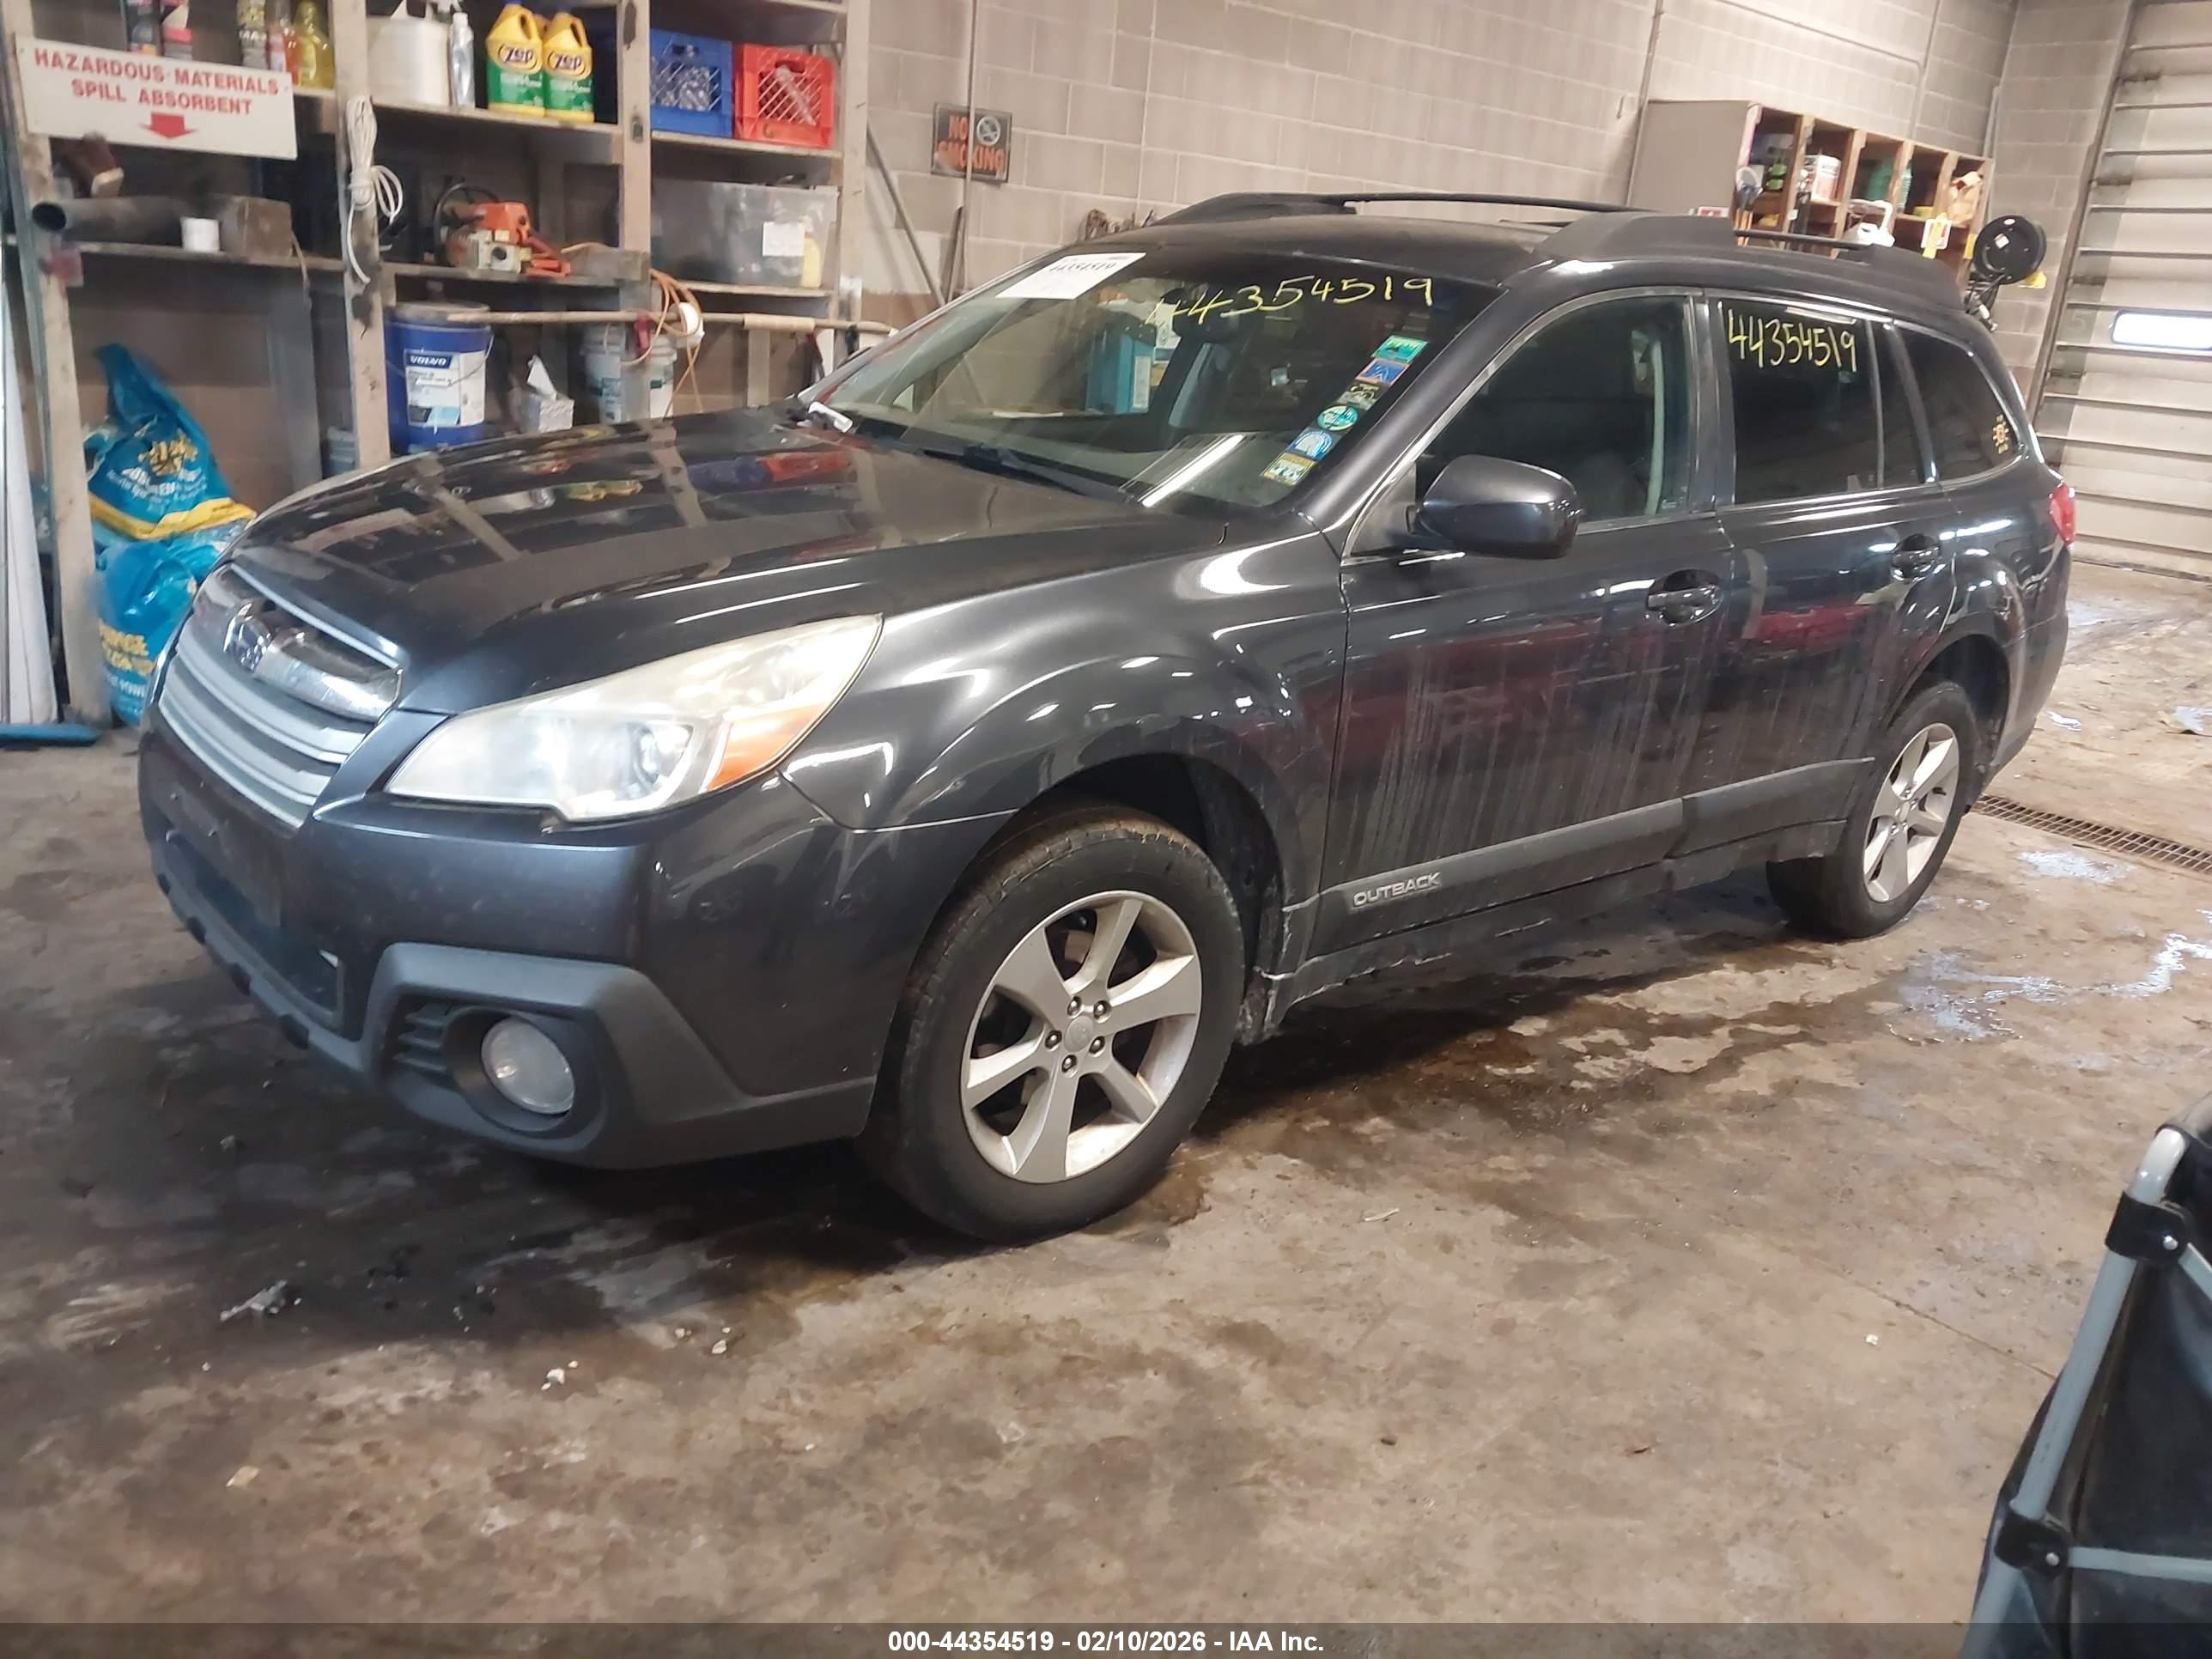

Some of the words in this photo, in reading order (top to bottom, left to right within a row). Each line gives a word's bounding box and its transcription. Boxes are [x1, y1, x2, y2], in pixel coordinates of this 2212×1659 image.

[34, 48, 165, 82] HAZARDOUS
[174, 68, 279, 95] MATERIALS
[71, 78, 126, 103] SPILL
[138, 88, 252, 115] ABSORBENT
[948, 114, 969, 140] NO
[1145, 275, 1434, 325] 44354519
[1728, 307, 1857, 373] 44354519
[410, 355, 448, 367] VOLVO
[1353, 872, 1441, 907] OUTBACK
